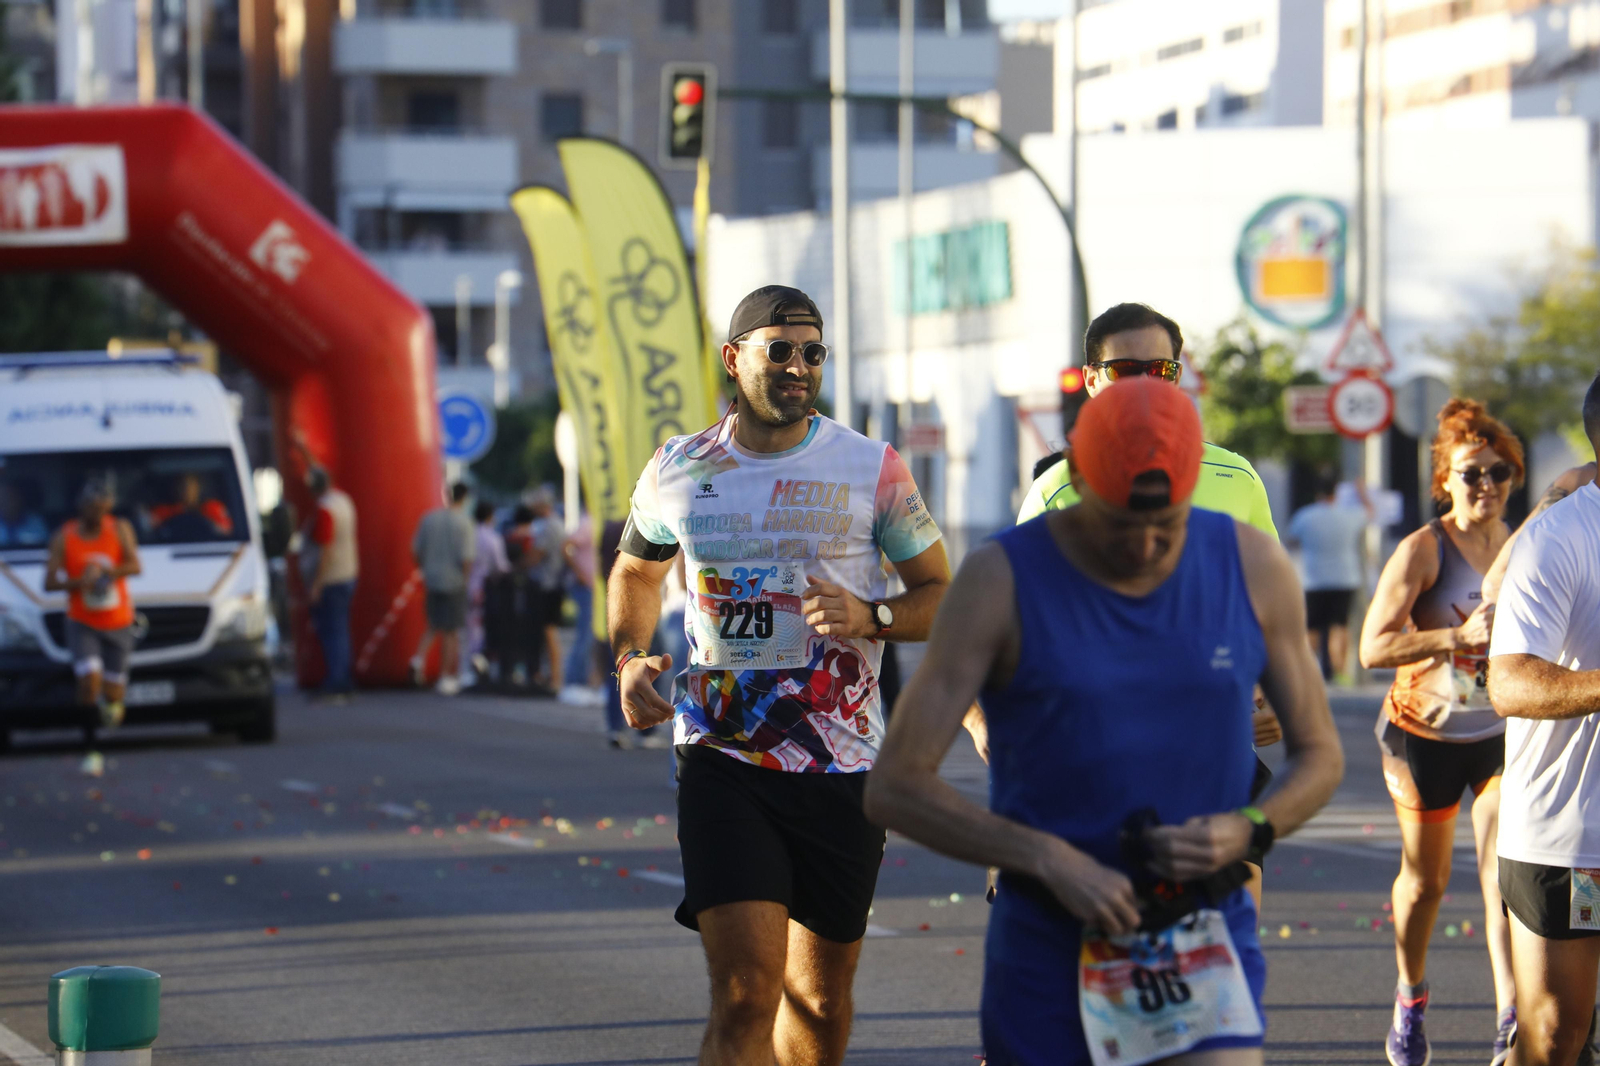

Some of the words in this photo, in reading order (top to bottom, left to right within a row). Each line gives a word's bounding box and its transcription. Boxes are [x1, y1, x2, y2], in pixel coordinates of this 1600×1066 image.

[769, 479, 850, 511] MEDIA
[678, 511, 752, 536] CÓRDOBA
[762, 508, 853, 536] MARATÓN
[777, 539, 811, 560] DEL
[815, 536, 848, 560] RÍO
[720, 601, 773, 639] 229
[1131, 967, 1192, 1013] 96
